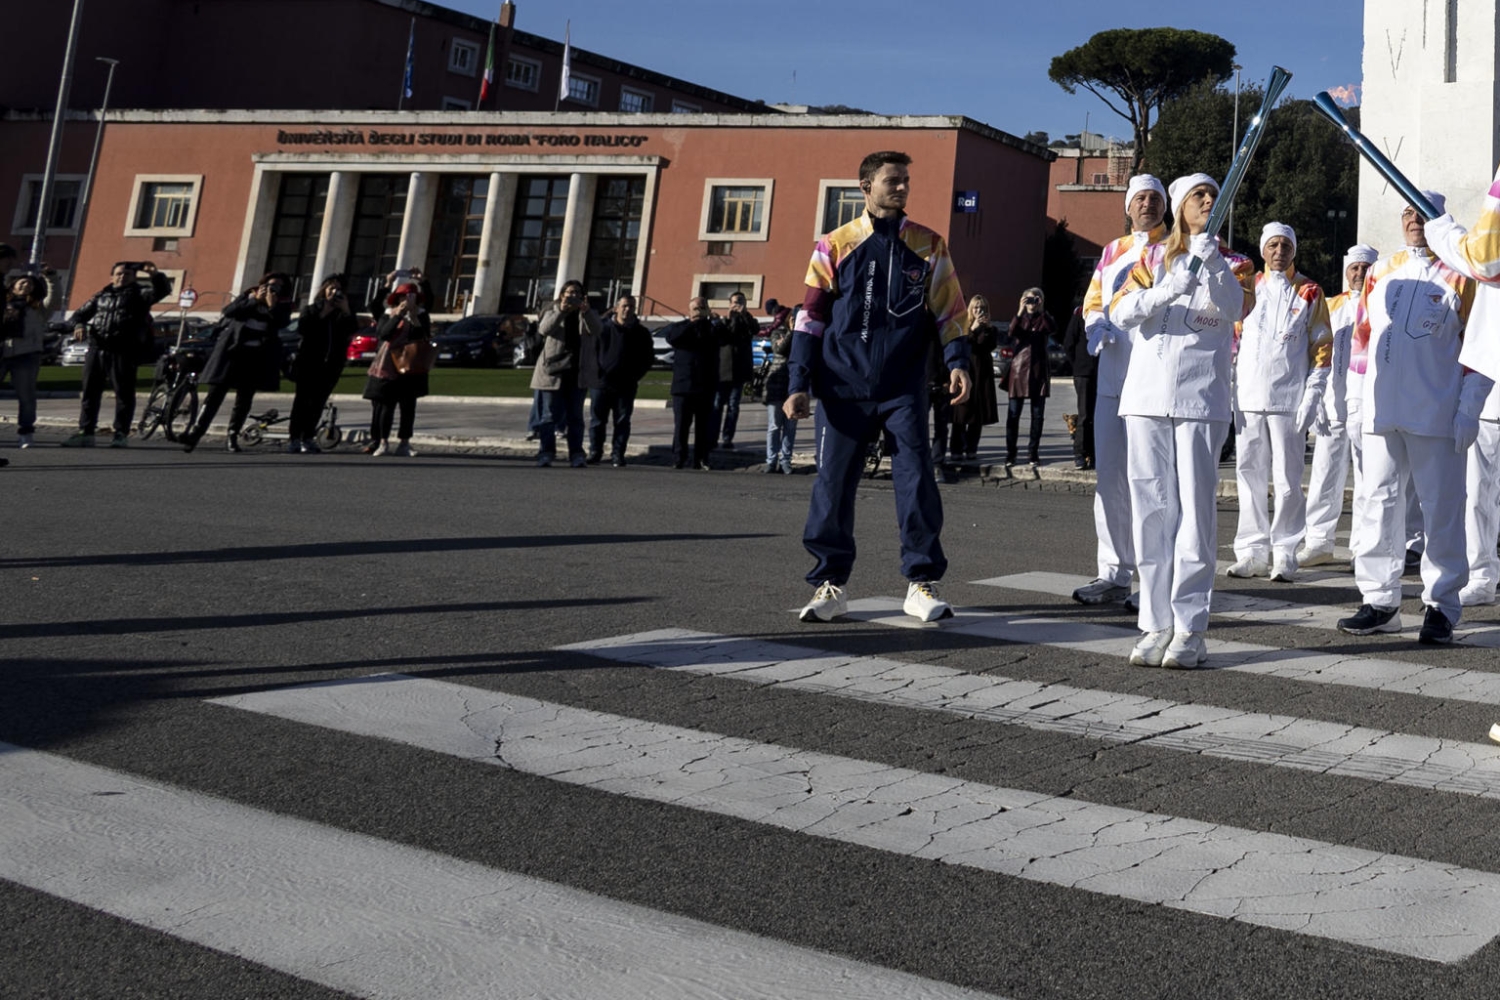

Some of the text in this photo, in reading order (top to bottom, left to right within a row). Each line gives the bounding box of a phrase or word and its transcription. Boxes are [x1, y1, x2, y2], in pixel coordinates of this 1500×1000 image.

[368, 130, 416, 146] DEGLI
[417, 133, 463, 146] STUDI
[465, 134, 482, 146] DI
[484, 134, 531, 146] ROMA
[957, 196, 976, 207] Rai
